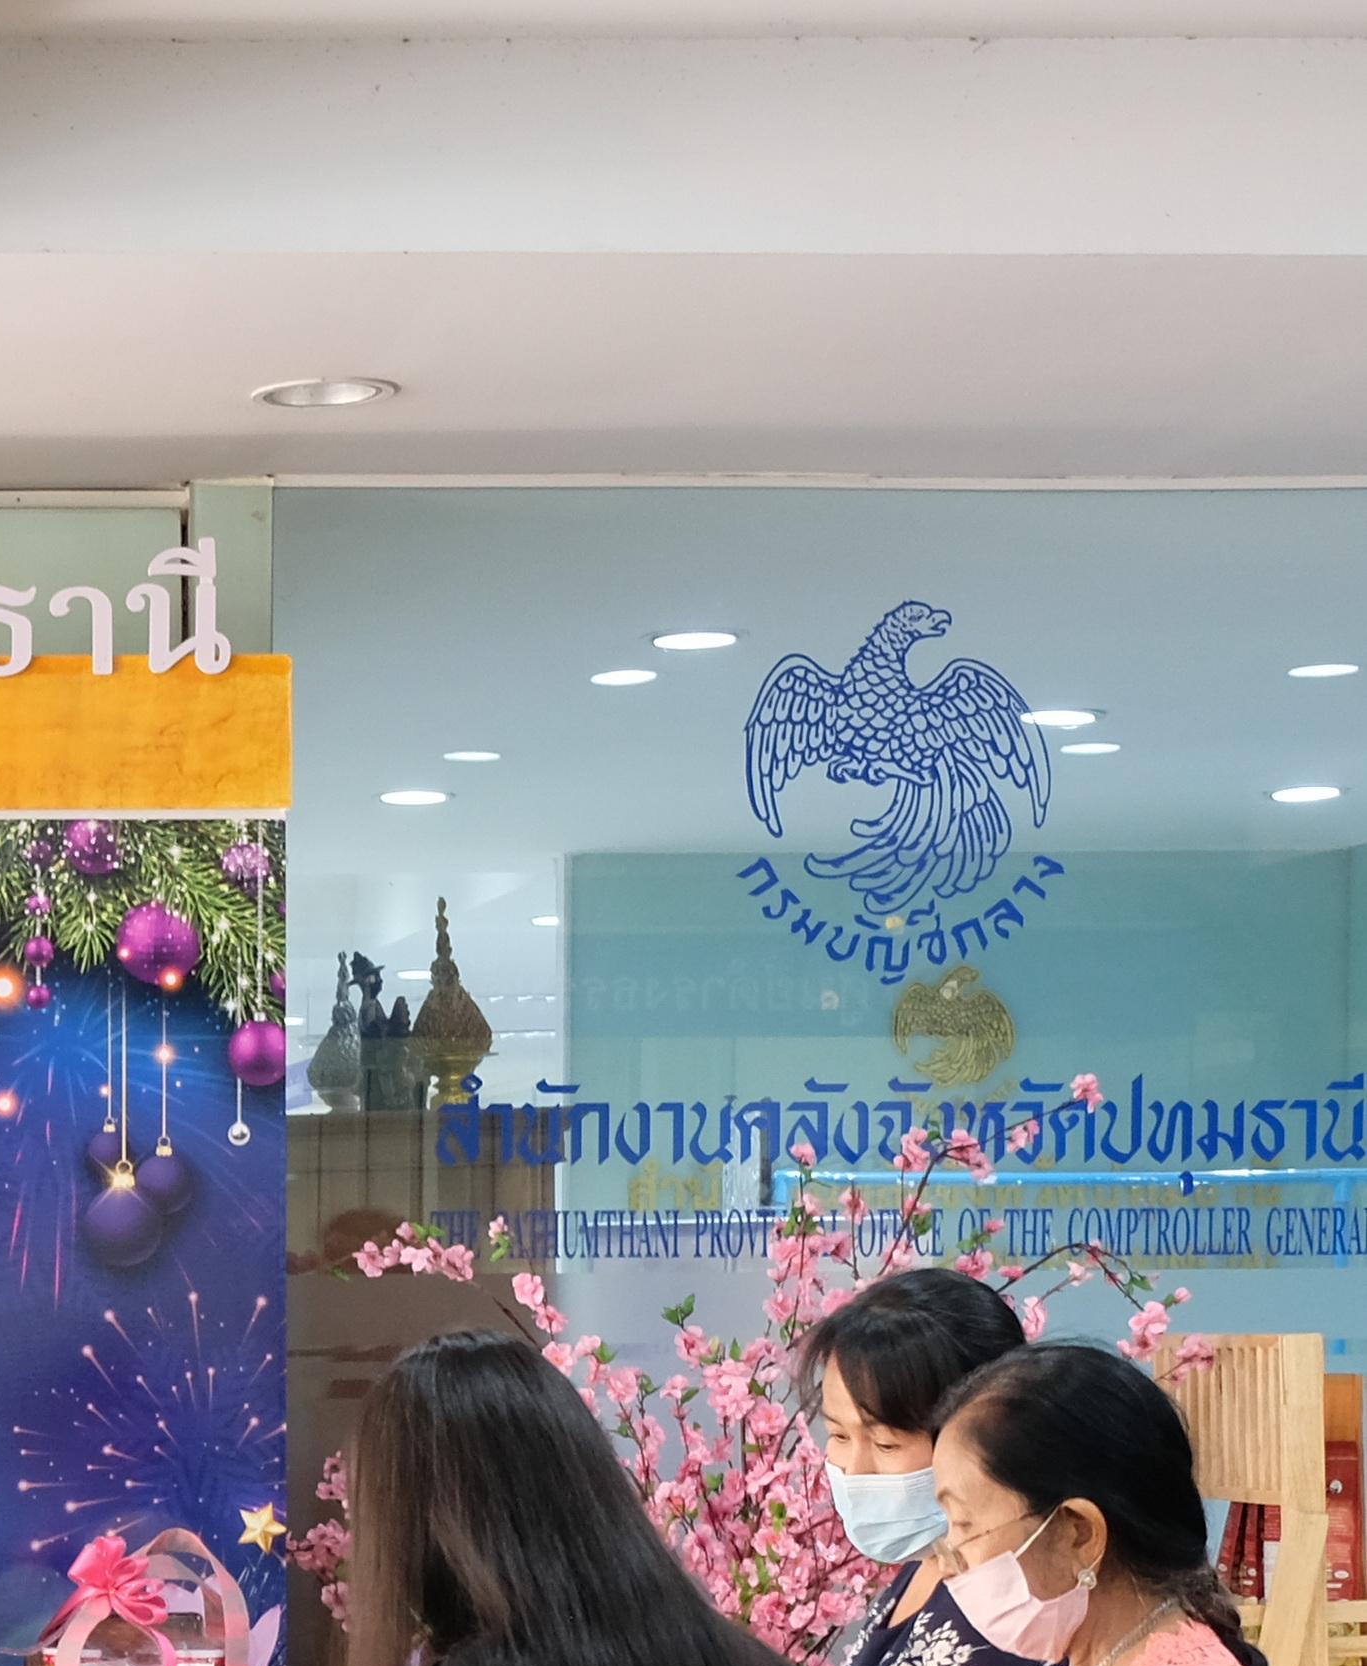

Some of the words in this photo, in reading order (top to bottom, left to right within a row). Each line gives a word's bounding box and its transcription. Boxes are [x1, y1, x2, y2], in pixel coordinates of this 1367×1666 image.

[734, 855, 1066, 985] กรมบัญชีกลาง
[493, 1208, 680, 1259] ATHUMTHANI
[1003, 1207, 1055, 1257] THE
[1068, 1207, 1253, 1258] COMPTROLLER
[1265, 1207, 1367, 1258] GENERA
